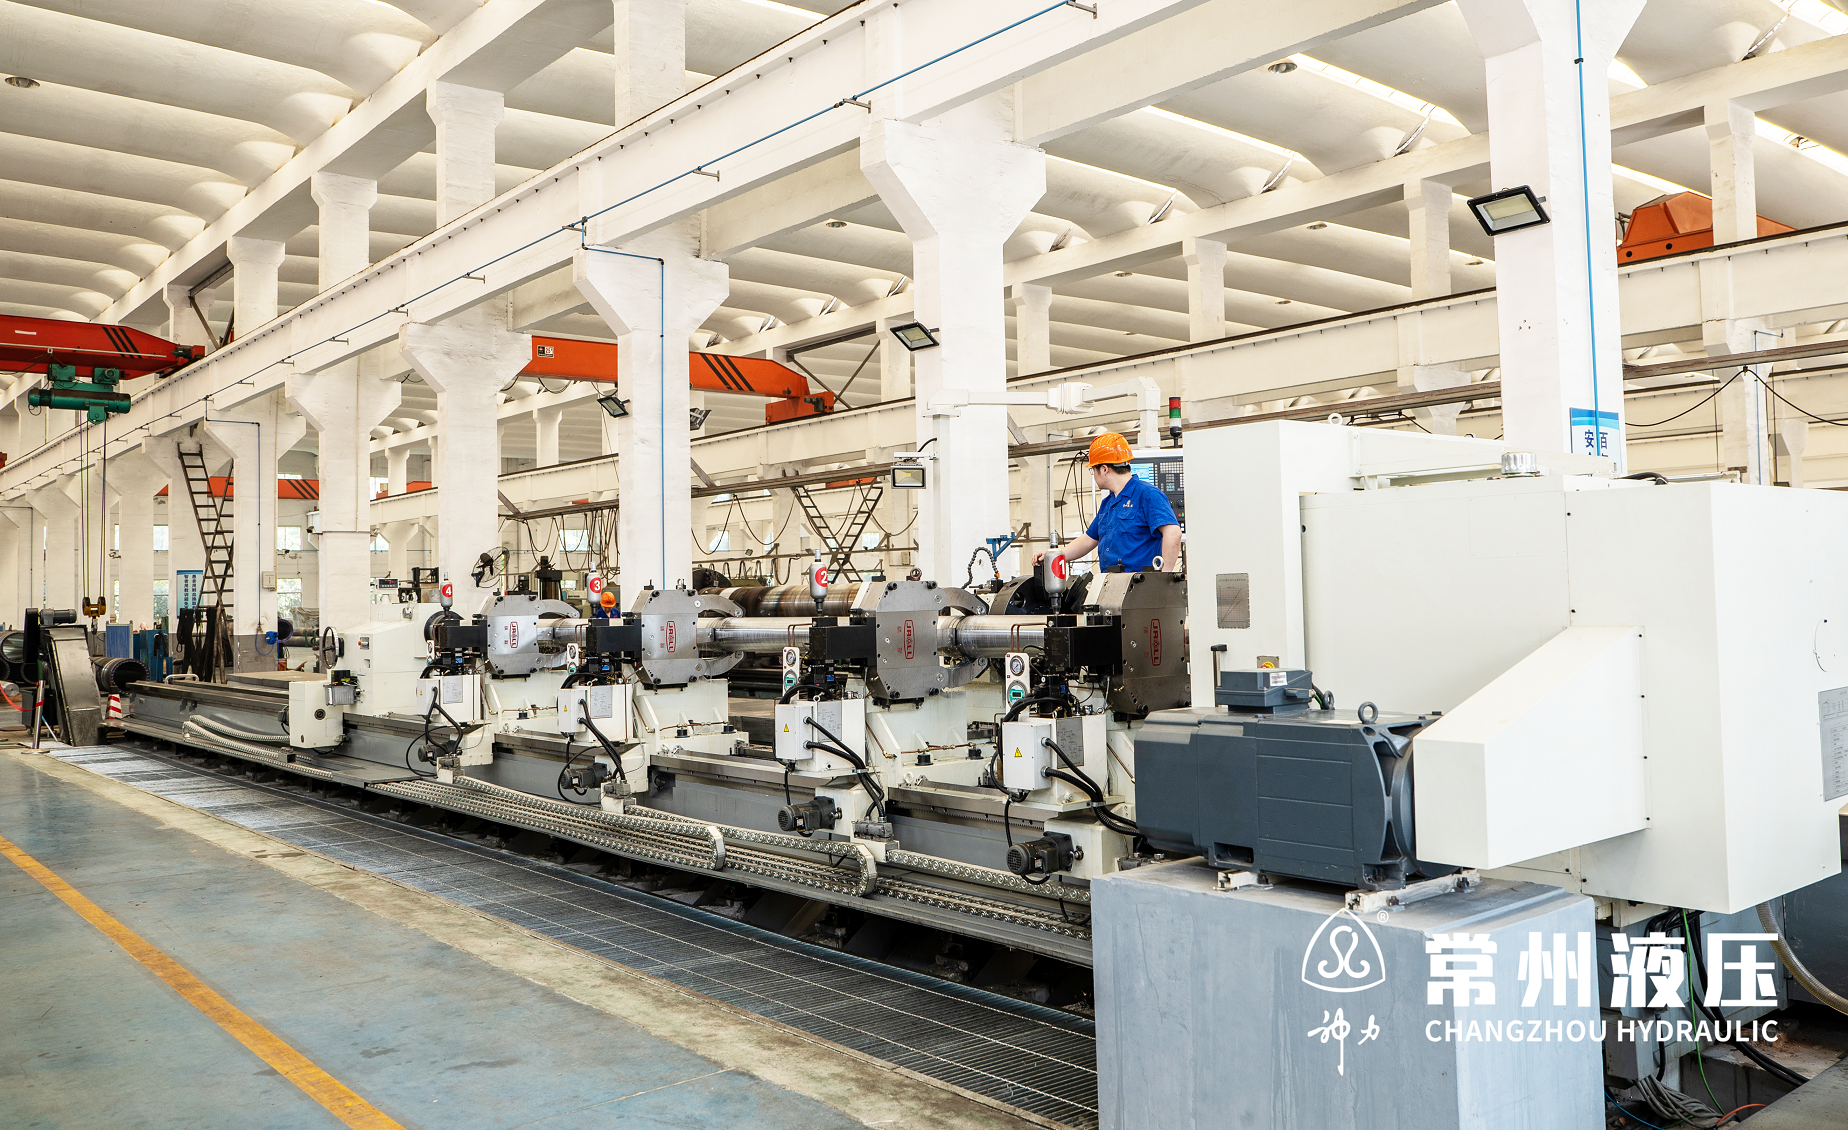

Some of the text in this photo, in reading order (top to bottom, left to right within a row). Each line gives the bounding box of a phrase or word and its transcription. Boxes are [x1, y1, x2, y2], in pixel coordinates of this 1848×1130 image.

[1584, 430, 1594, 456] 安
[1599, 432, 1608, 457] 百
[1059, 559, 1066, 575] 1
[820, 570, 828, 584] 2
[445, 586, 452, 595] 4
[594, 580, 600, 591] 3
